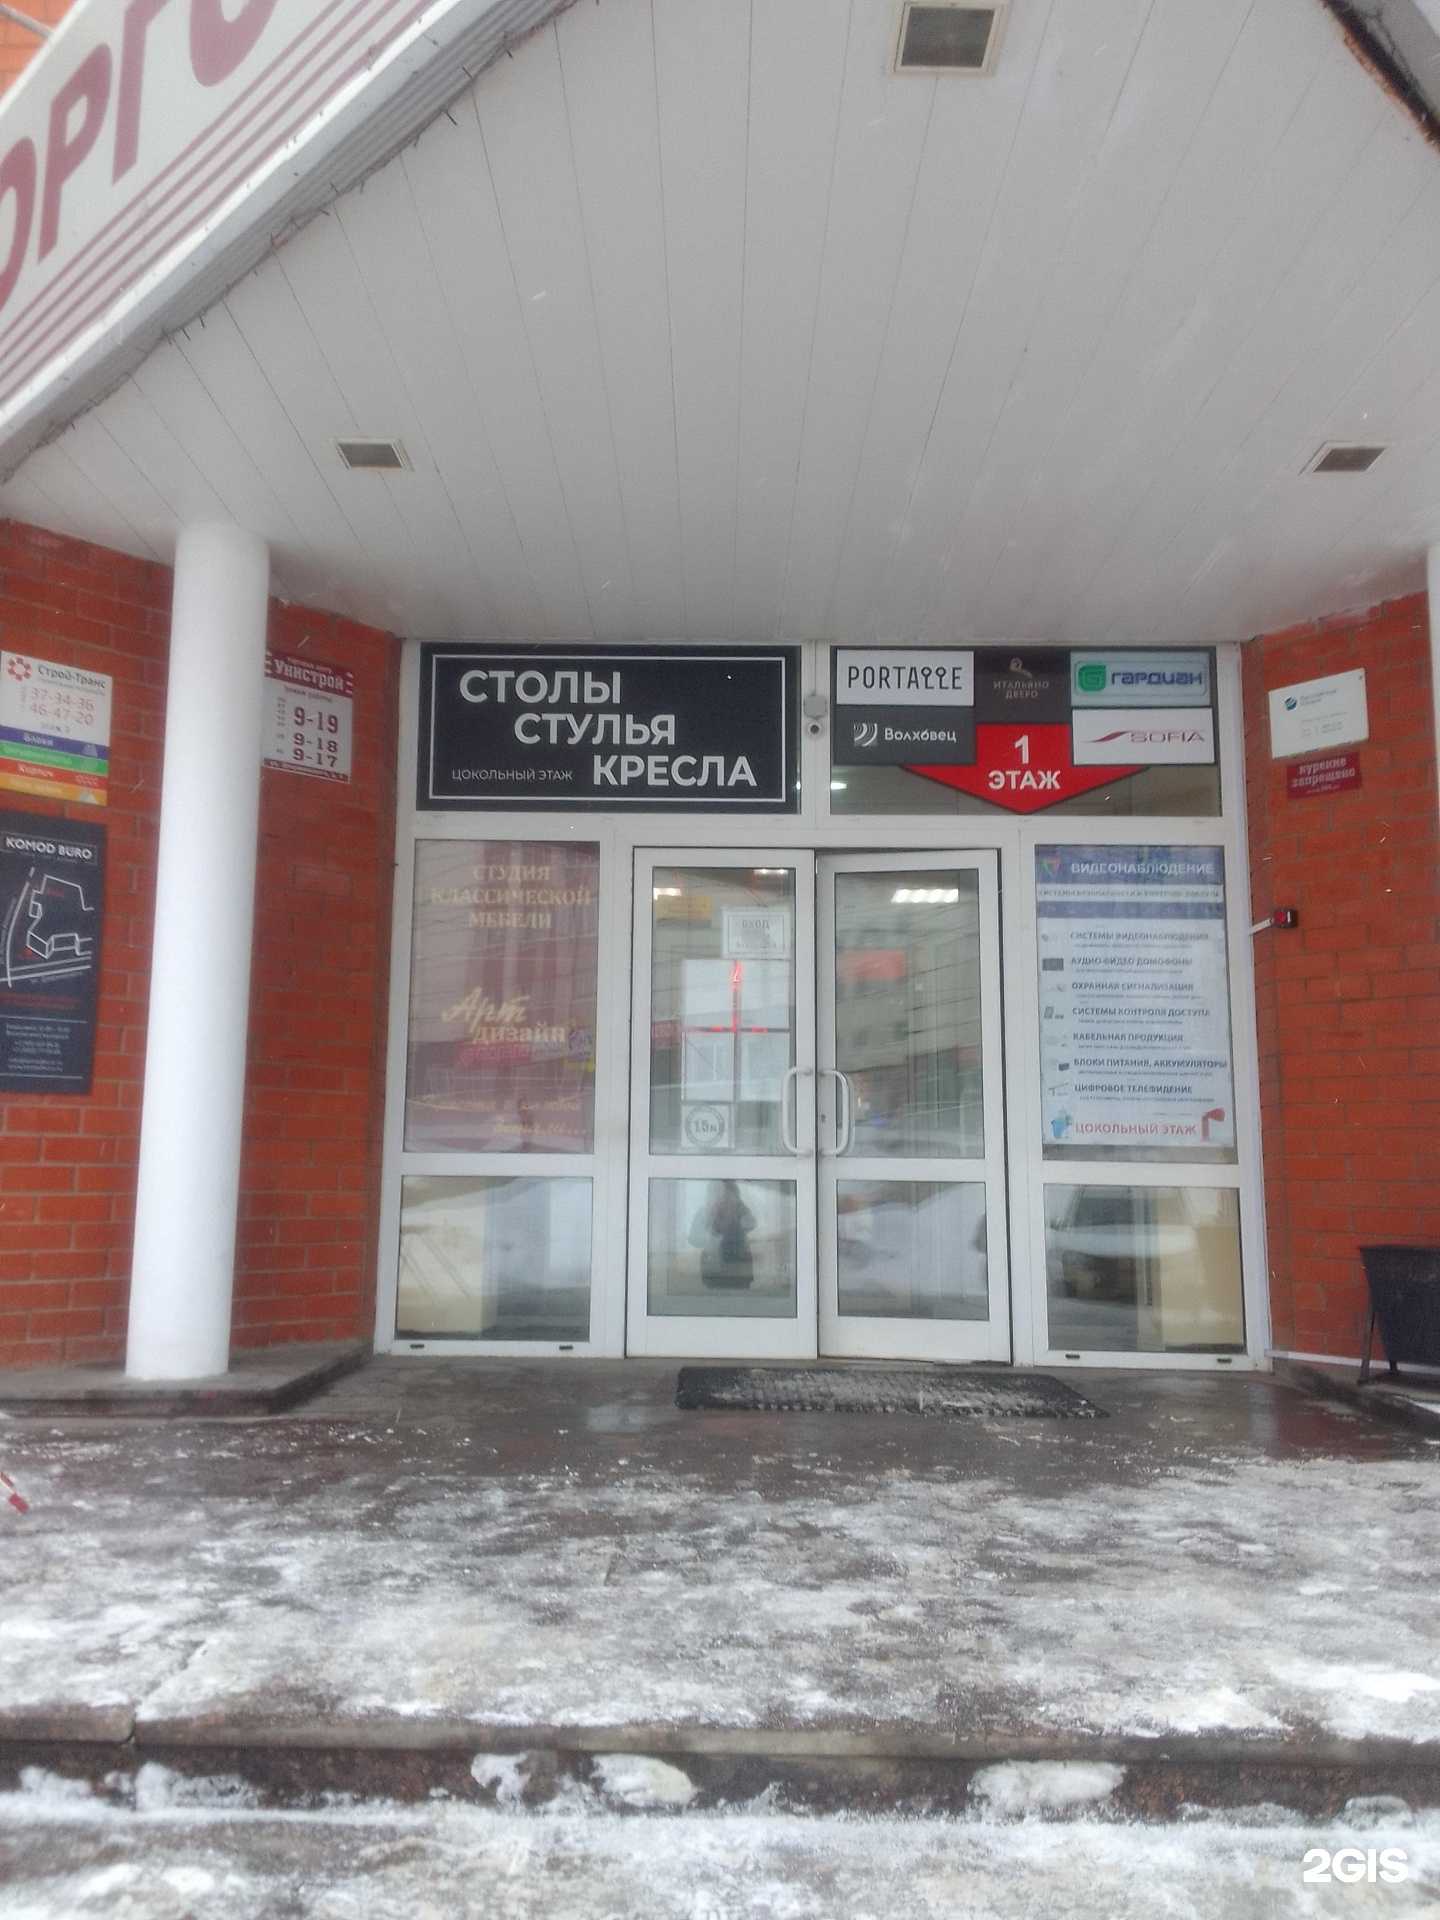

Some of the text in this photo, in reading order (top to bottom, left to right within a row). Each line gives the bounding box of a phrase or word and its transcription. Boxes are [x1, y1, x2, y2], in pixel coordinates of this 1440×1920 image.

[459, 670, 621, 704] СТОЛЫ
[294, 706, 339, 734] 9-19
[513, 712, 676, 746] СТУЛЬЯ
[293, 732, 338, 754] 9-18
[1130, 730, 1206, 744] SOFIA
[293, 747, 338, 768] 9-17
[1013, 735, 1030, 765] 1
[452, 767, 573, 783] ЦОКОЛЬНЫЙ ЭТАЖ
[593, 755, 758, 787] КРЕСЛА
[988, 770, 1061, 791] ЭТАЖ
[6, 836, 56, 854] KOMOD
[473, 864, 550, 881] СТУДИЯ
[1071, 863, 1214, 875] ВИДЕОНАБЛЮДЕНИЕ
[431, 883, 592, 905] КЛАССИЧЕСКОЙ
[468, 911, 552, 929] МЕБЕЛИ
[1072, 1007, 1116, 1017] СИСТЕМЫ
[1076, 1120, 1198, 1136] ЦОКОЛЬНЫЙ ЭТАЖ
